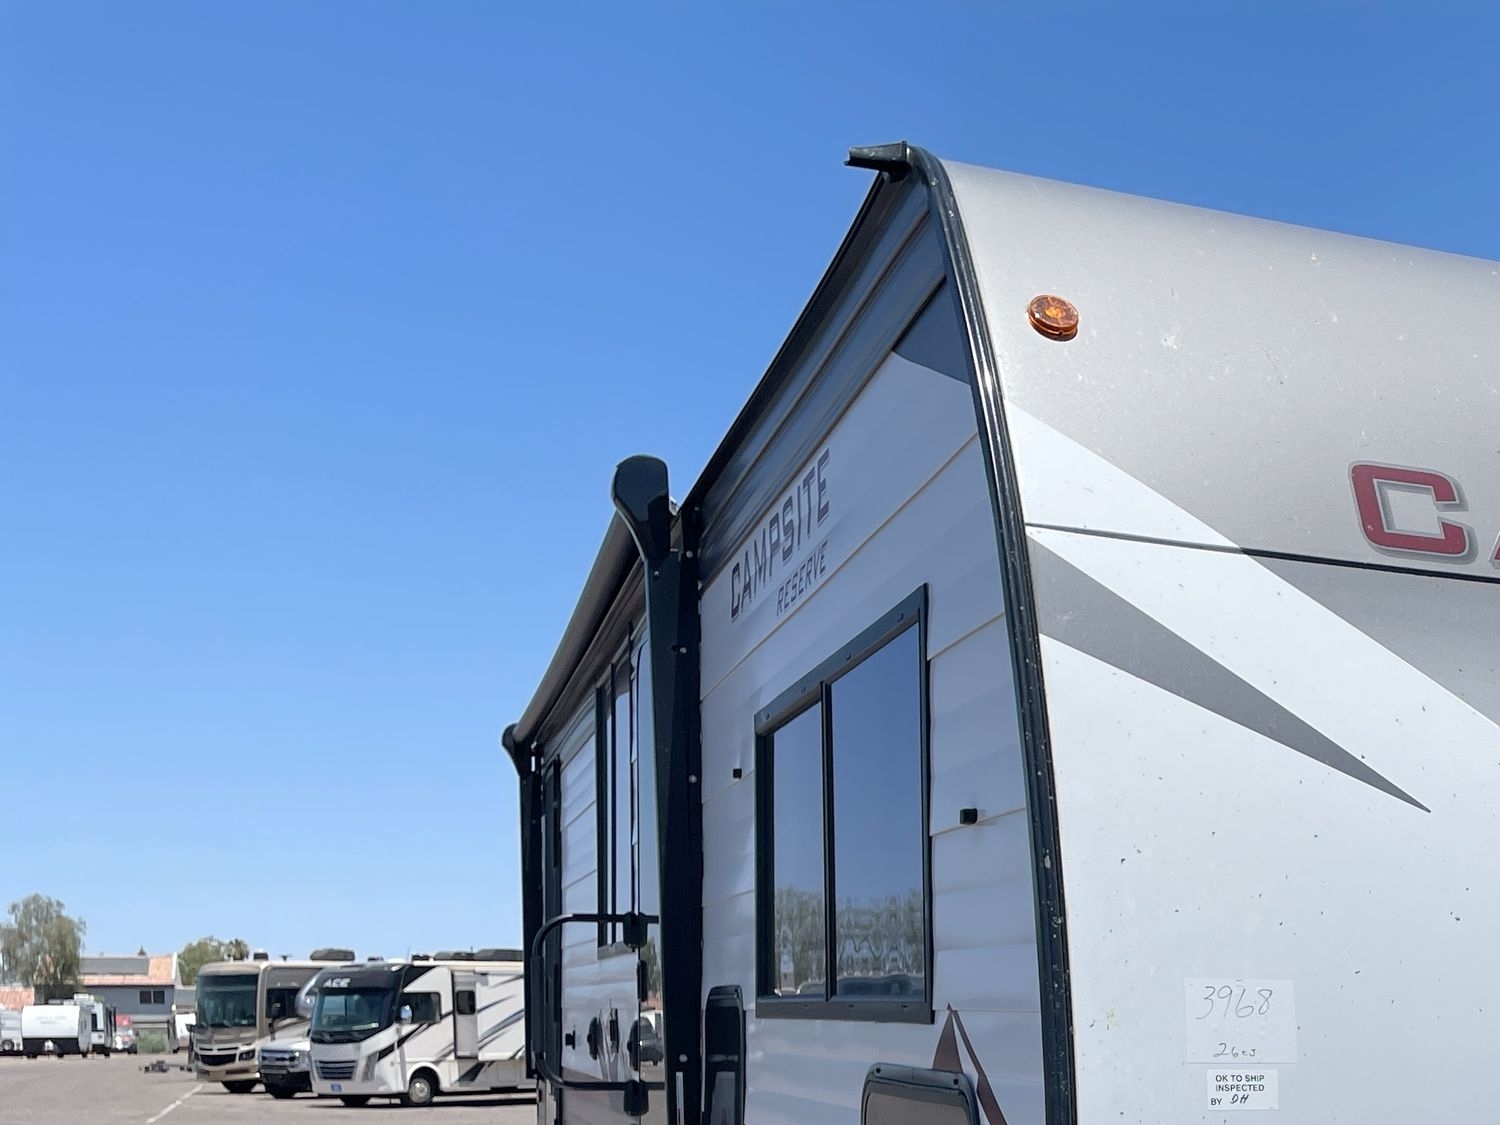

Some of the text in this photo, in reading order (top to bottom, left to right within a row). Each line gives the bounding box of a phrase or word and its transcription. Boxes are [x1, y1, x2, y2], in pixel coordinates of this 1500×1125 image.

[730, 448, 830, 621] CAMPSITE
[776, 540, 829, 616] RESERVE
[1195, 985, 1273, 1020] 3968
[1215, 1074, 1265, 1083] OK TO SHIP
[1215, 1084, 1265, 1092] INSPECTED
[1210, 1098, 1222, 1106] BY
